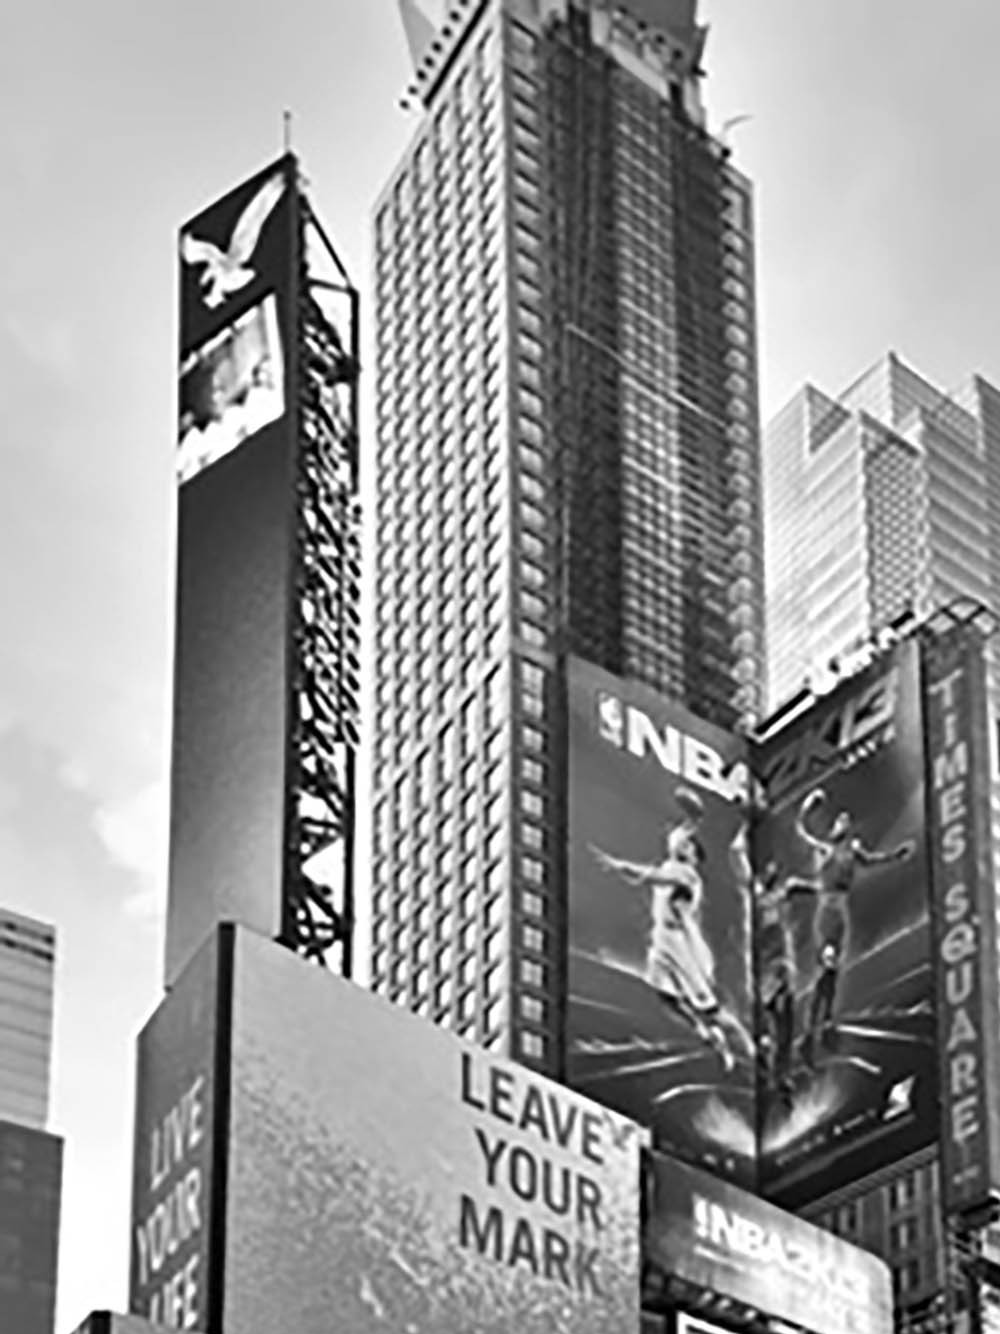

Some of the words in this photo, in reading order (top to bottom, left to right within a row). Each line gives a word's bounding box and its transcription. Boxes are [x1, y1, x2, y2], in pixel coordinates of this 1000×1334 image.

[928, 667, 968, 864] TIMES
[941, 882, 980, 1143] SQUARE
[151, 1075, 204, 1191] LIVE
[462, 1051, 604, 1166] LEAVE
[136, 1166, 201, 1285] YOUR
[474, 1127, 605, 1231] YOUR
[460, 1193, 605, 1298] MARK
